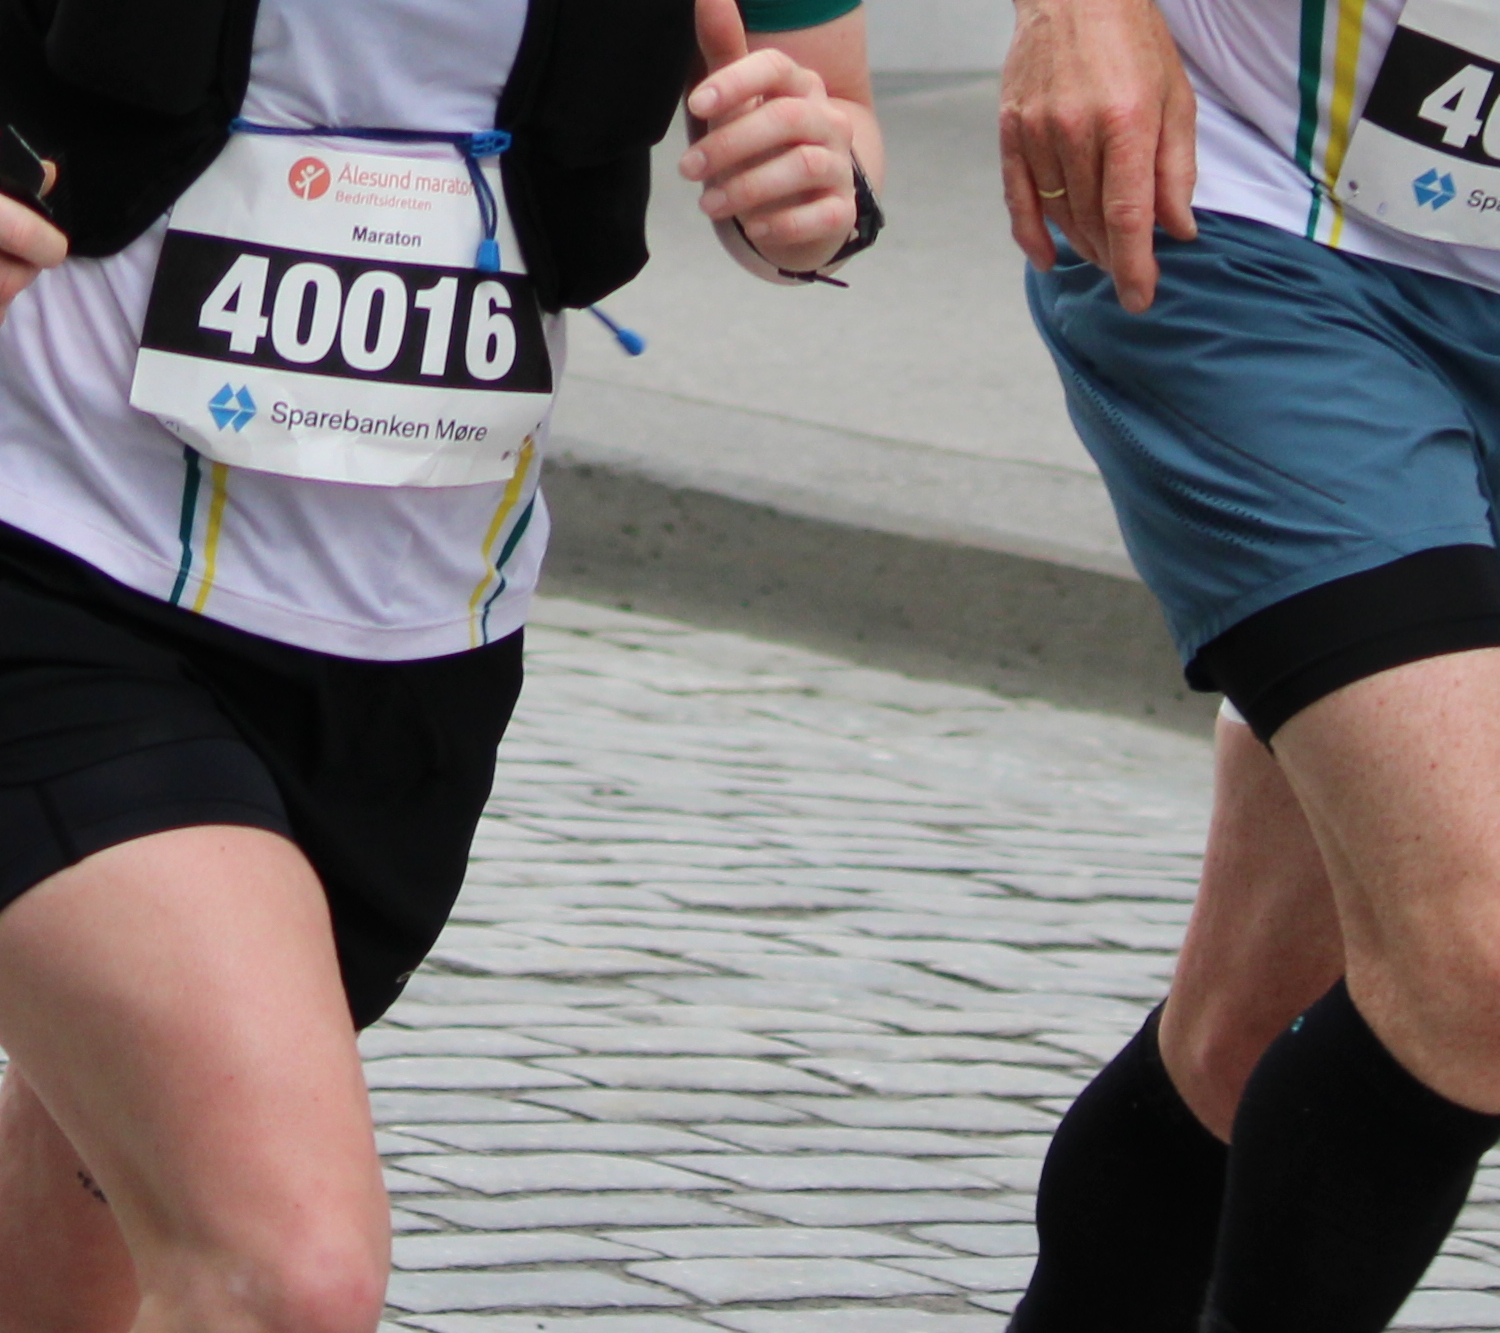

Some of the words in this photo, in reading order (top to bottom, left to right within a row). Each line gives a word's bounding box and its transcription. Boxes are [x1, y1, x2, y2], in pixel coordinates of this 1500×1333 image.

[337, 161, 412, 191] Ålesund
[335, 189, 432, 212] Bedriftsidretten
[351, 225, 422, 248] Maraton
[198, 252, 518, 382] 40016
[270, 401, 430, 441] Sparebanken
[435, 419, 488, 443] Møre
